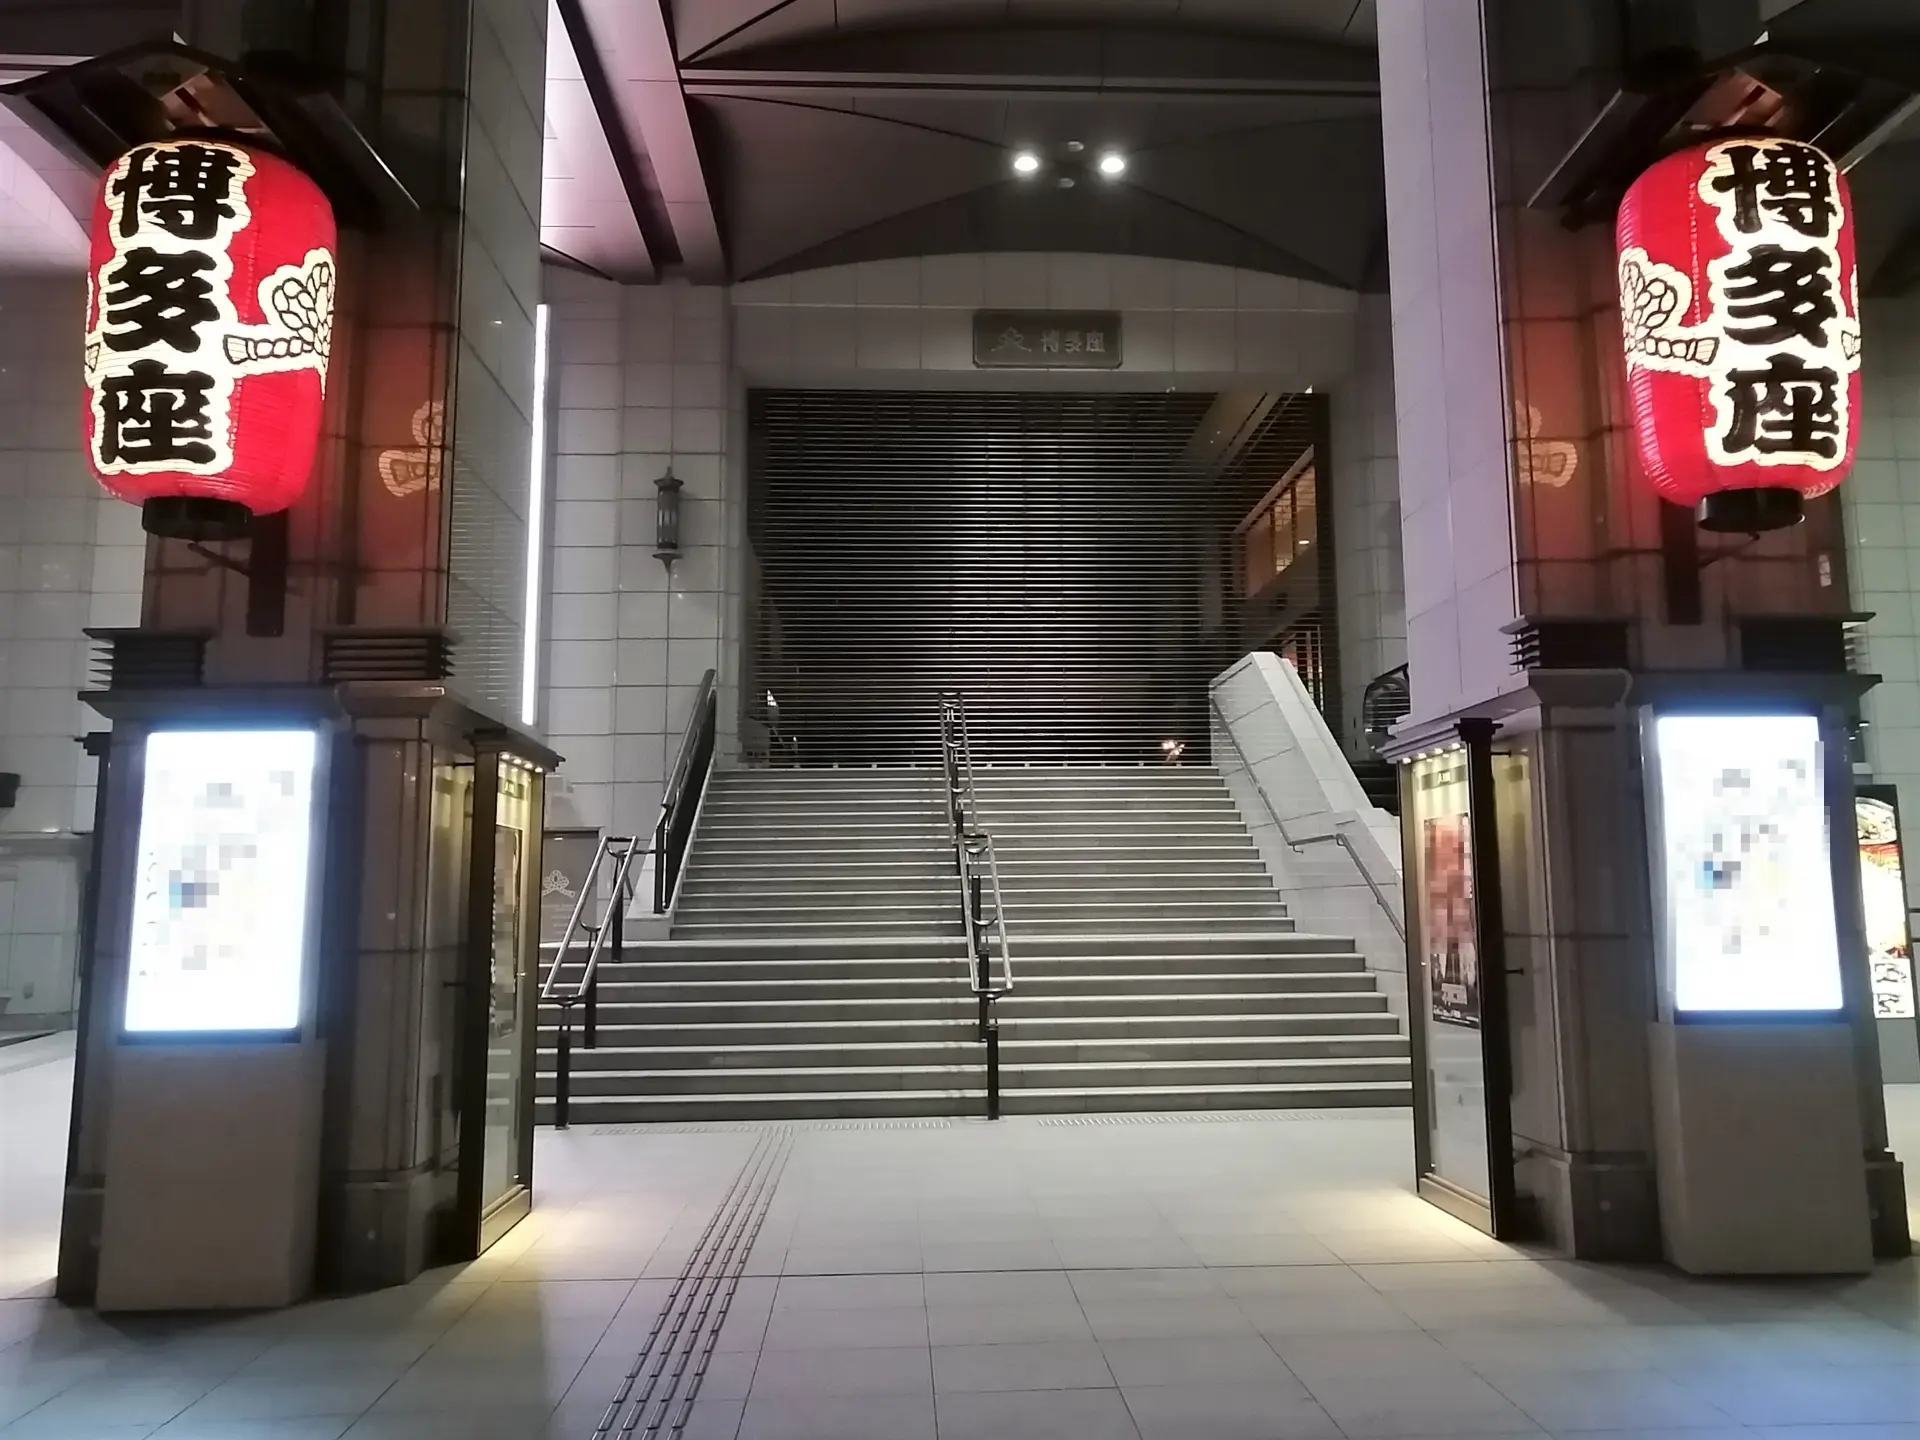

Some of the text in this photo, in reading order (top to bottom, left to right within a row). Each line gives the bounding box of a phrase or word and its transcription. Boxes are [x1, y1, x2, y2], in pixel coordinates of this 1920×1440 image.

[99, 145, 241, 465] 博多座
[1711, 142, 1838, 459] 博多座
